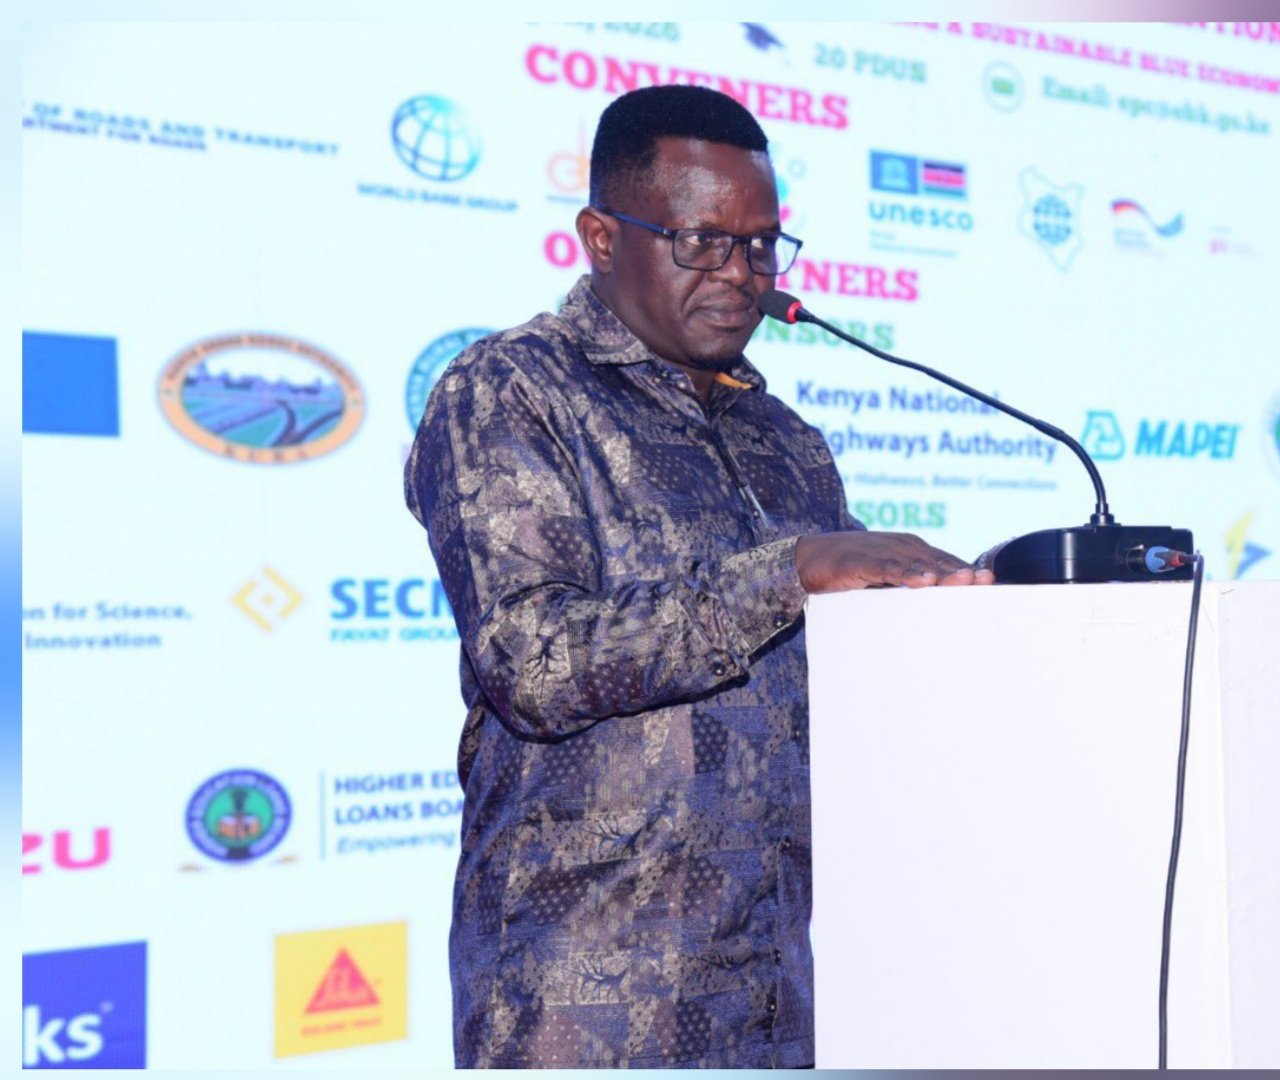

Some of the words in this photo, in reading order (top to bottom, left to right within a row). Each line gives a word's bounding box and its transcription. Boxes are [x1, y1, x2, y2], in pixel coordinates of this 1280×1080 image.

[815, 43, 846, 69] 20
[869, 200, 974, 231] unesco
[796, 380, 881, 414] Kenya
[938, 429, 1059, 464] Authority
[1134, 419, 1241, 460] MAPEI
[25, 632, 162, 650] Innovation
[334, 775, 427, 795] HIGHER
[334, 804, 414, 826] LOANS
